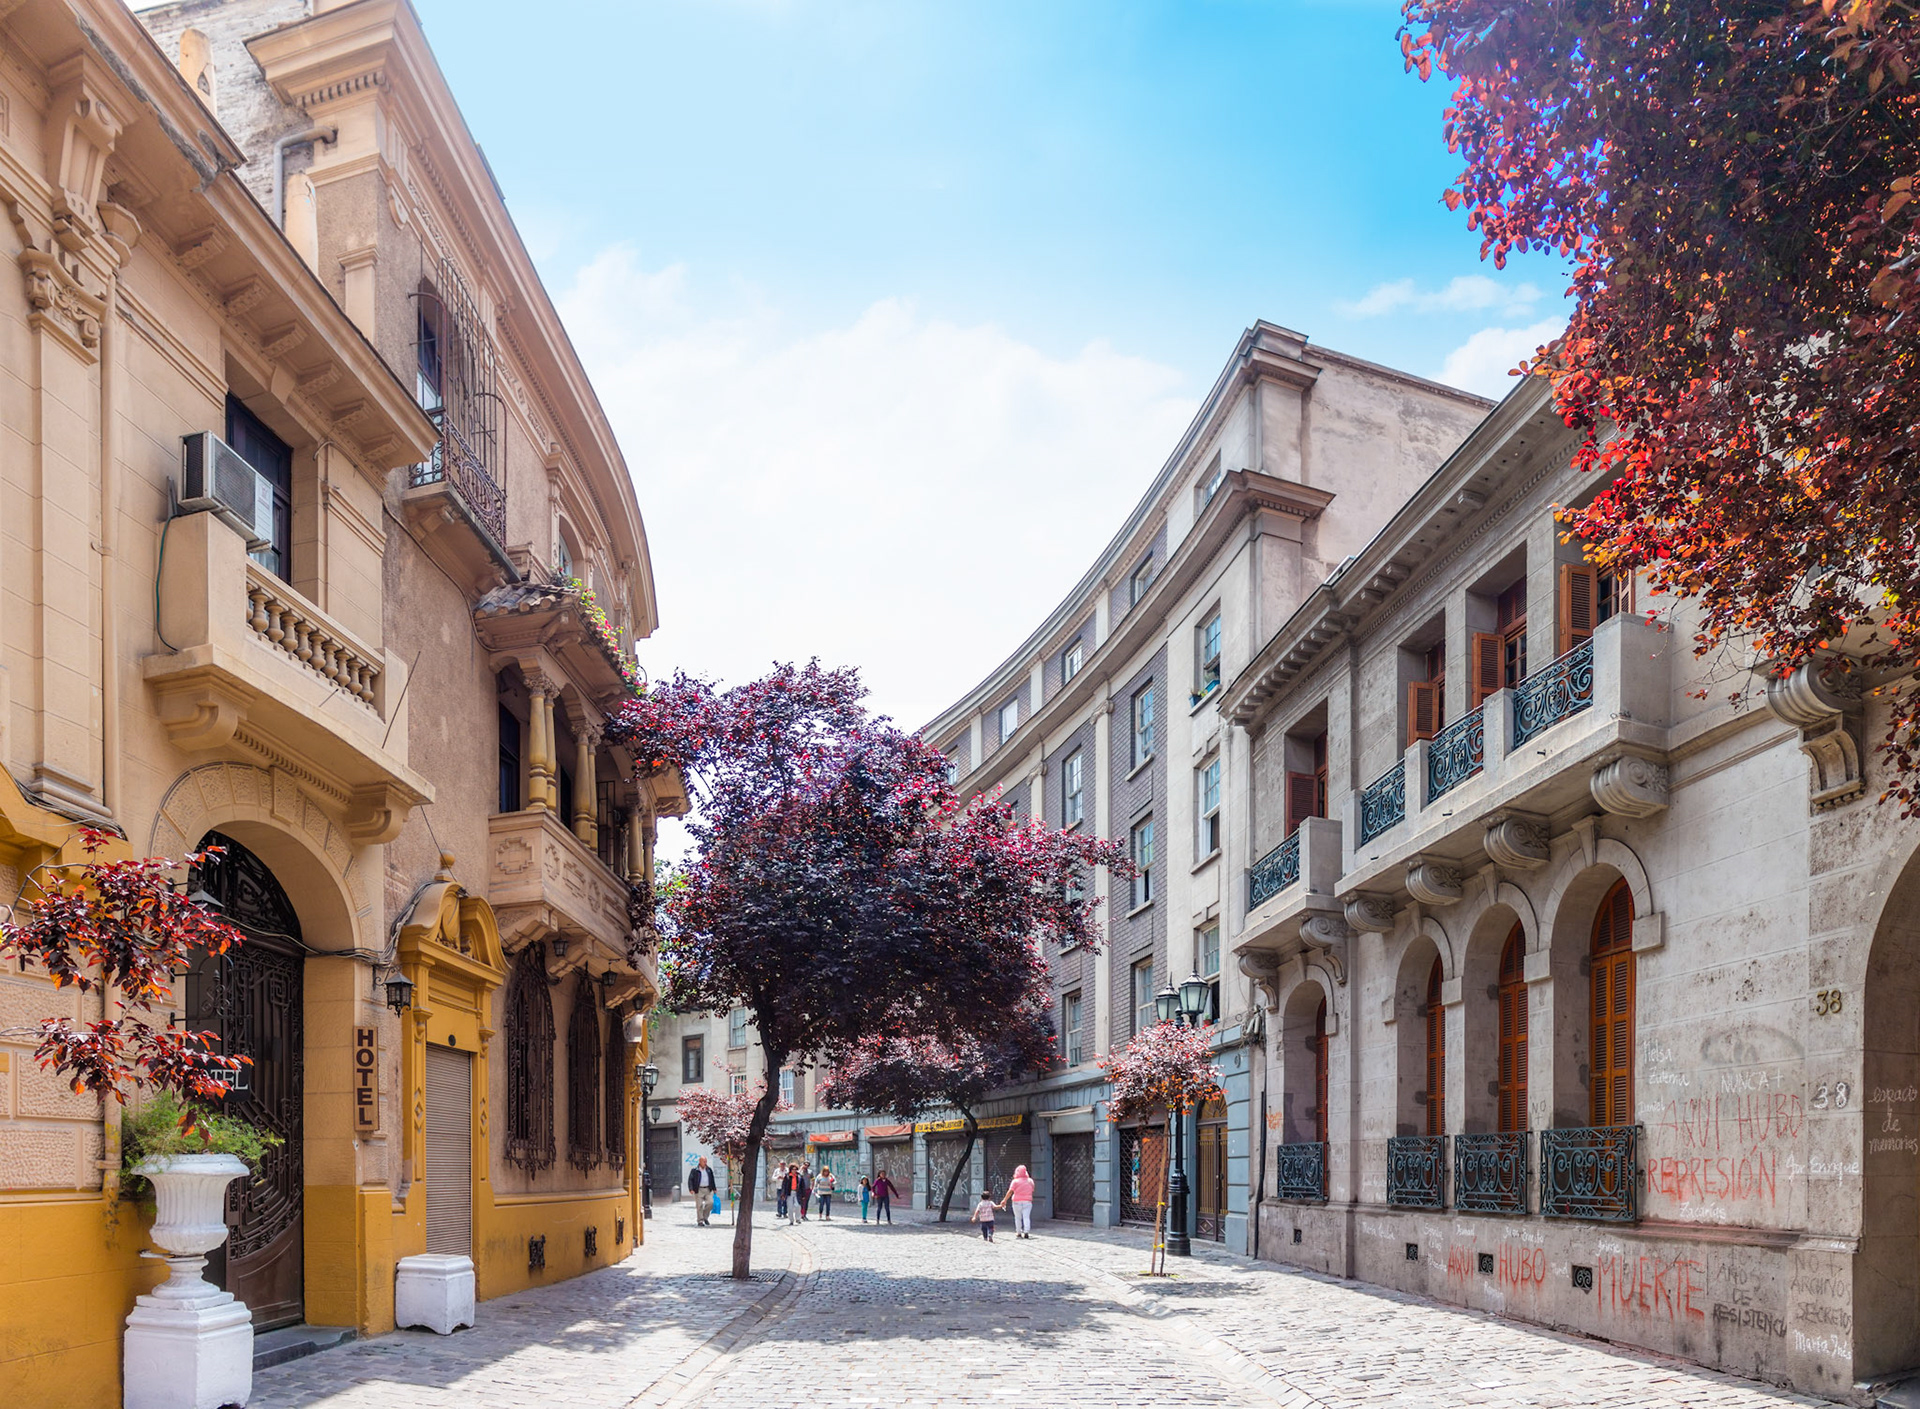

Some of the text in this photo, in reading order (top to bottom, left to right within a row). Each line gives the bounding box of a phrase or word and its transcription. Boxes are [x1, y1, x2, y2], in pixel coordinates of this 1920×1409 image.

[1816, 989, 1842, 1016] 38
[356, 1029, 375, 1126] HOTEL
[1721, 1071, 1769, 1093] NUNCA
[1813, 1081, 1848, 1109] 38
[1648, 1144, 1776, 1208] REPRESIÓN
[1499, 1242, 1546, 1287] HUBO
[1598, 1255, 1705, 1324] MUERTE
